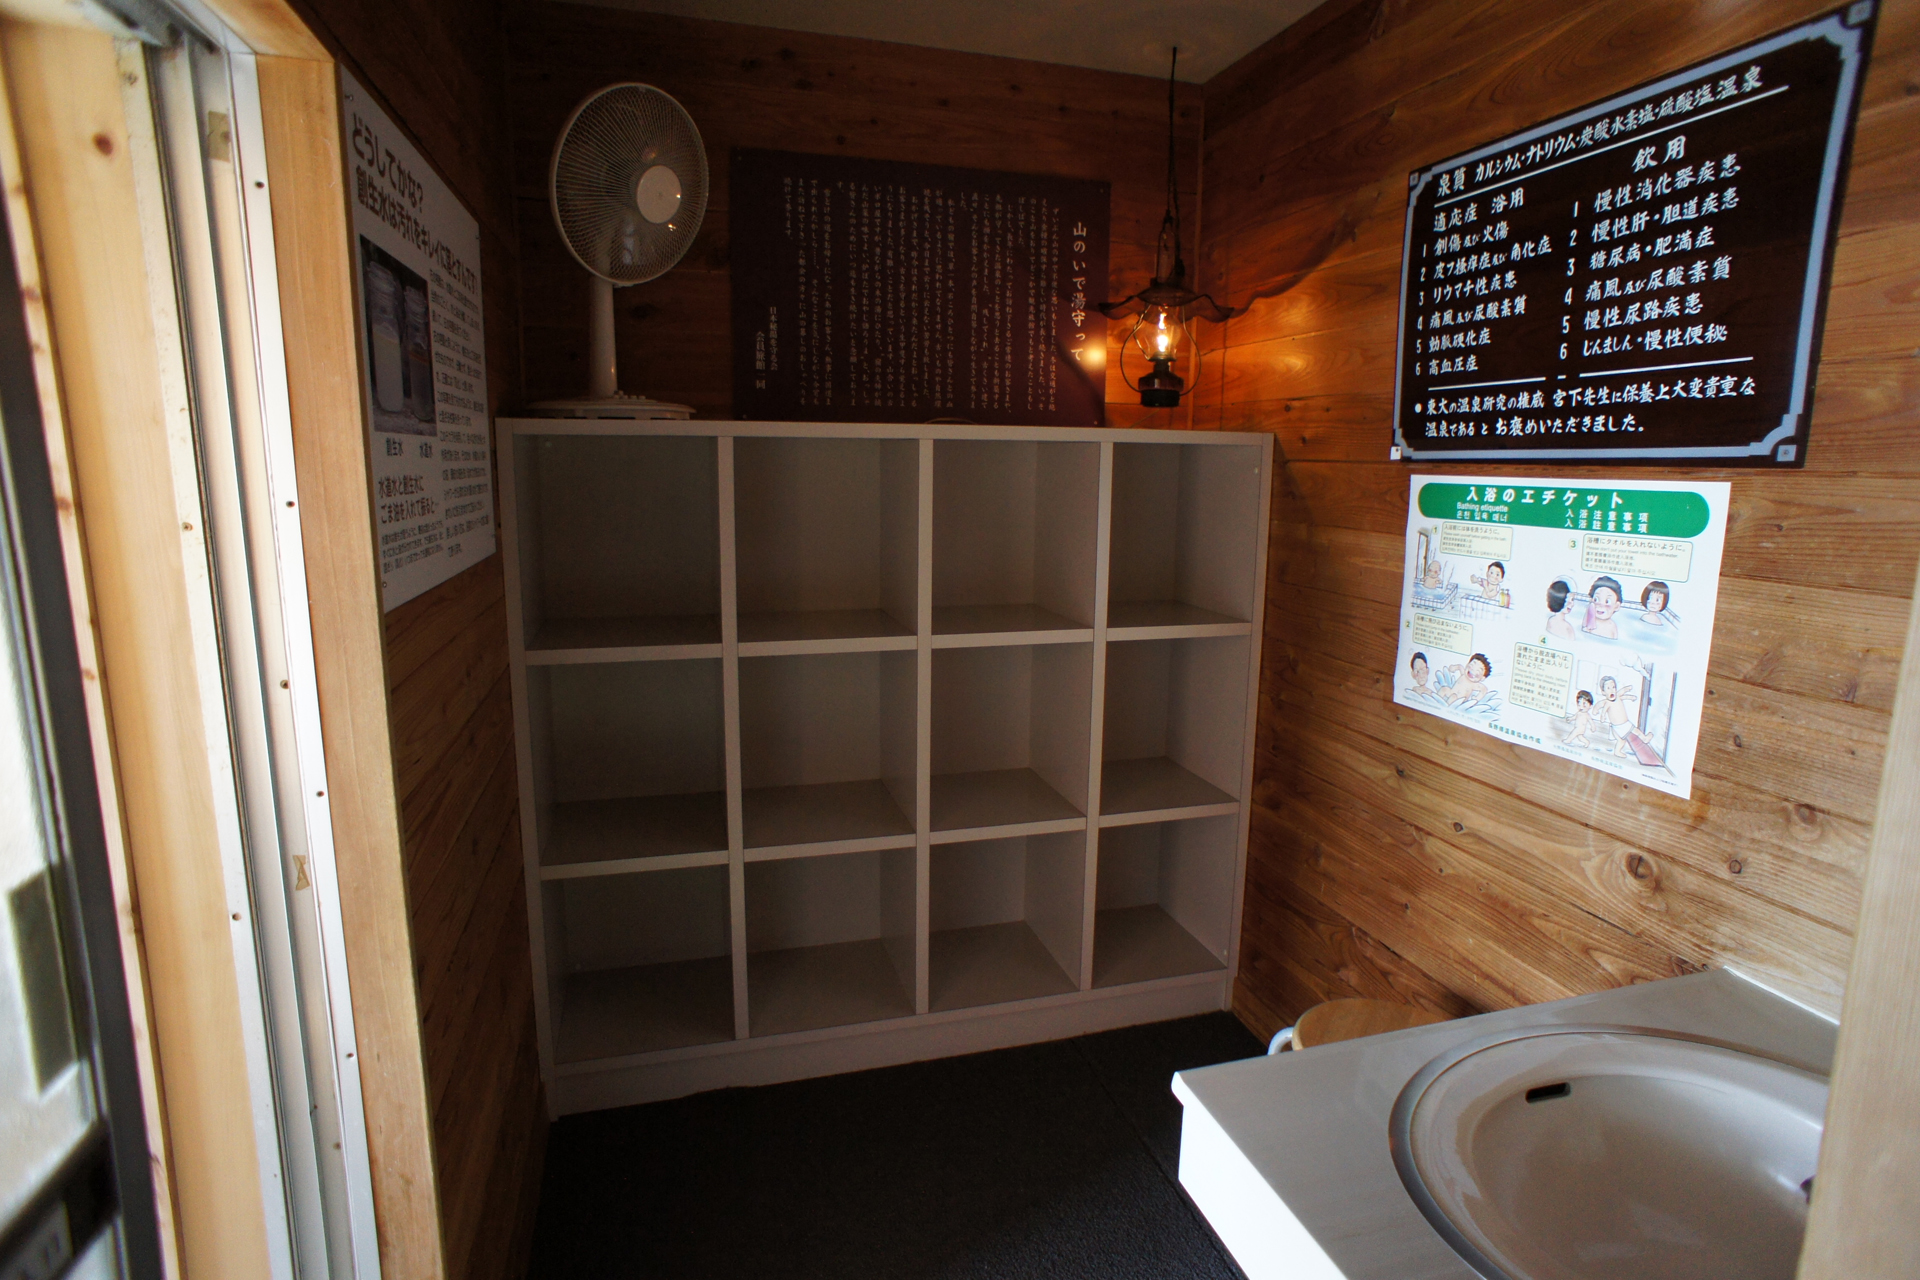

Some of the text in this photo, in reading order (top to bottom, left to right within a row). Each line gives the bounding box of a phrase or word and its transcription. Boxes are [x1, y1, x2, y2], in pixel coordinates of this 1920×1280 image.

[1632, 135, 1686, 173] 飲用
[1437, 166, 1467, 197] 泉質
[1573, 153, 1741, 217] 1 慢性消化器疾患
[1433, 187, 1524, 232] 適応症 浴用
[1433, 220, 1509, 256] 創傷及び火傷
[1569, 229, 1577, 246] 2
[1420, 267, 1426, 282] 2
[1566, 258, 1575, 277] 3
[1070, 222, 1087, 361] 山のいで湯守って
[1418, 270, 1517, 306] 3 リウマチ性疾患
[1564, 287, 1573, 305] 4
[1417, 316, 1423, 331] 4
[1562, 292, 1704, 334] 5 慢性尿路疾患
[1415, 327, 1492, 354] 5 動脈硬化症
[1559, 343, 1568, 360] 6
[1415, 354, 1479, 376] 6 高血圧症
[1457, 502, 1509, 514] Bathing etiquette
[1466, 485, 1624, 509] 入浴のエチケット
[1586, 536, 1686, 553] 浴槽にタオルを入れないように。
